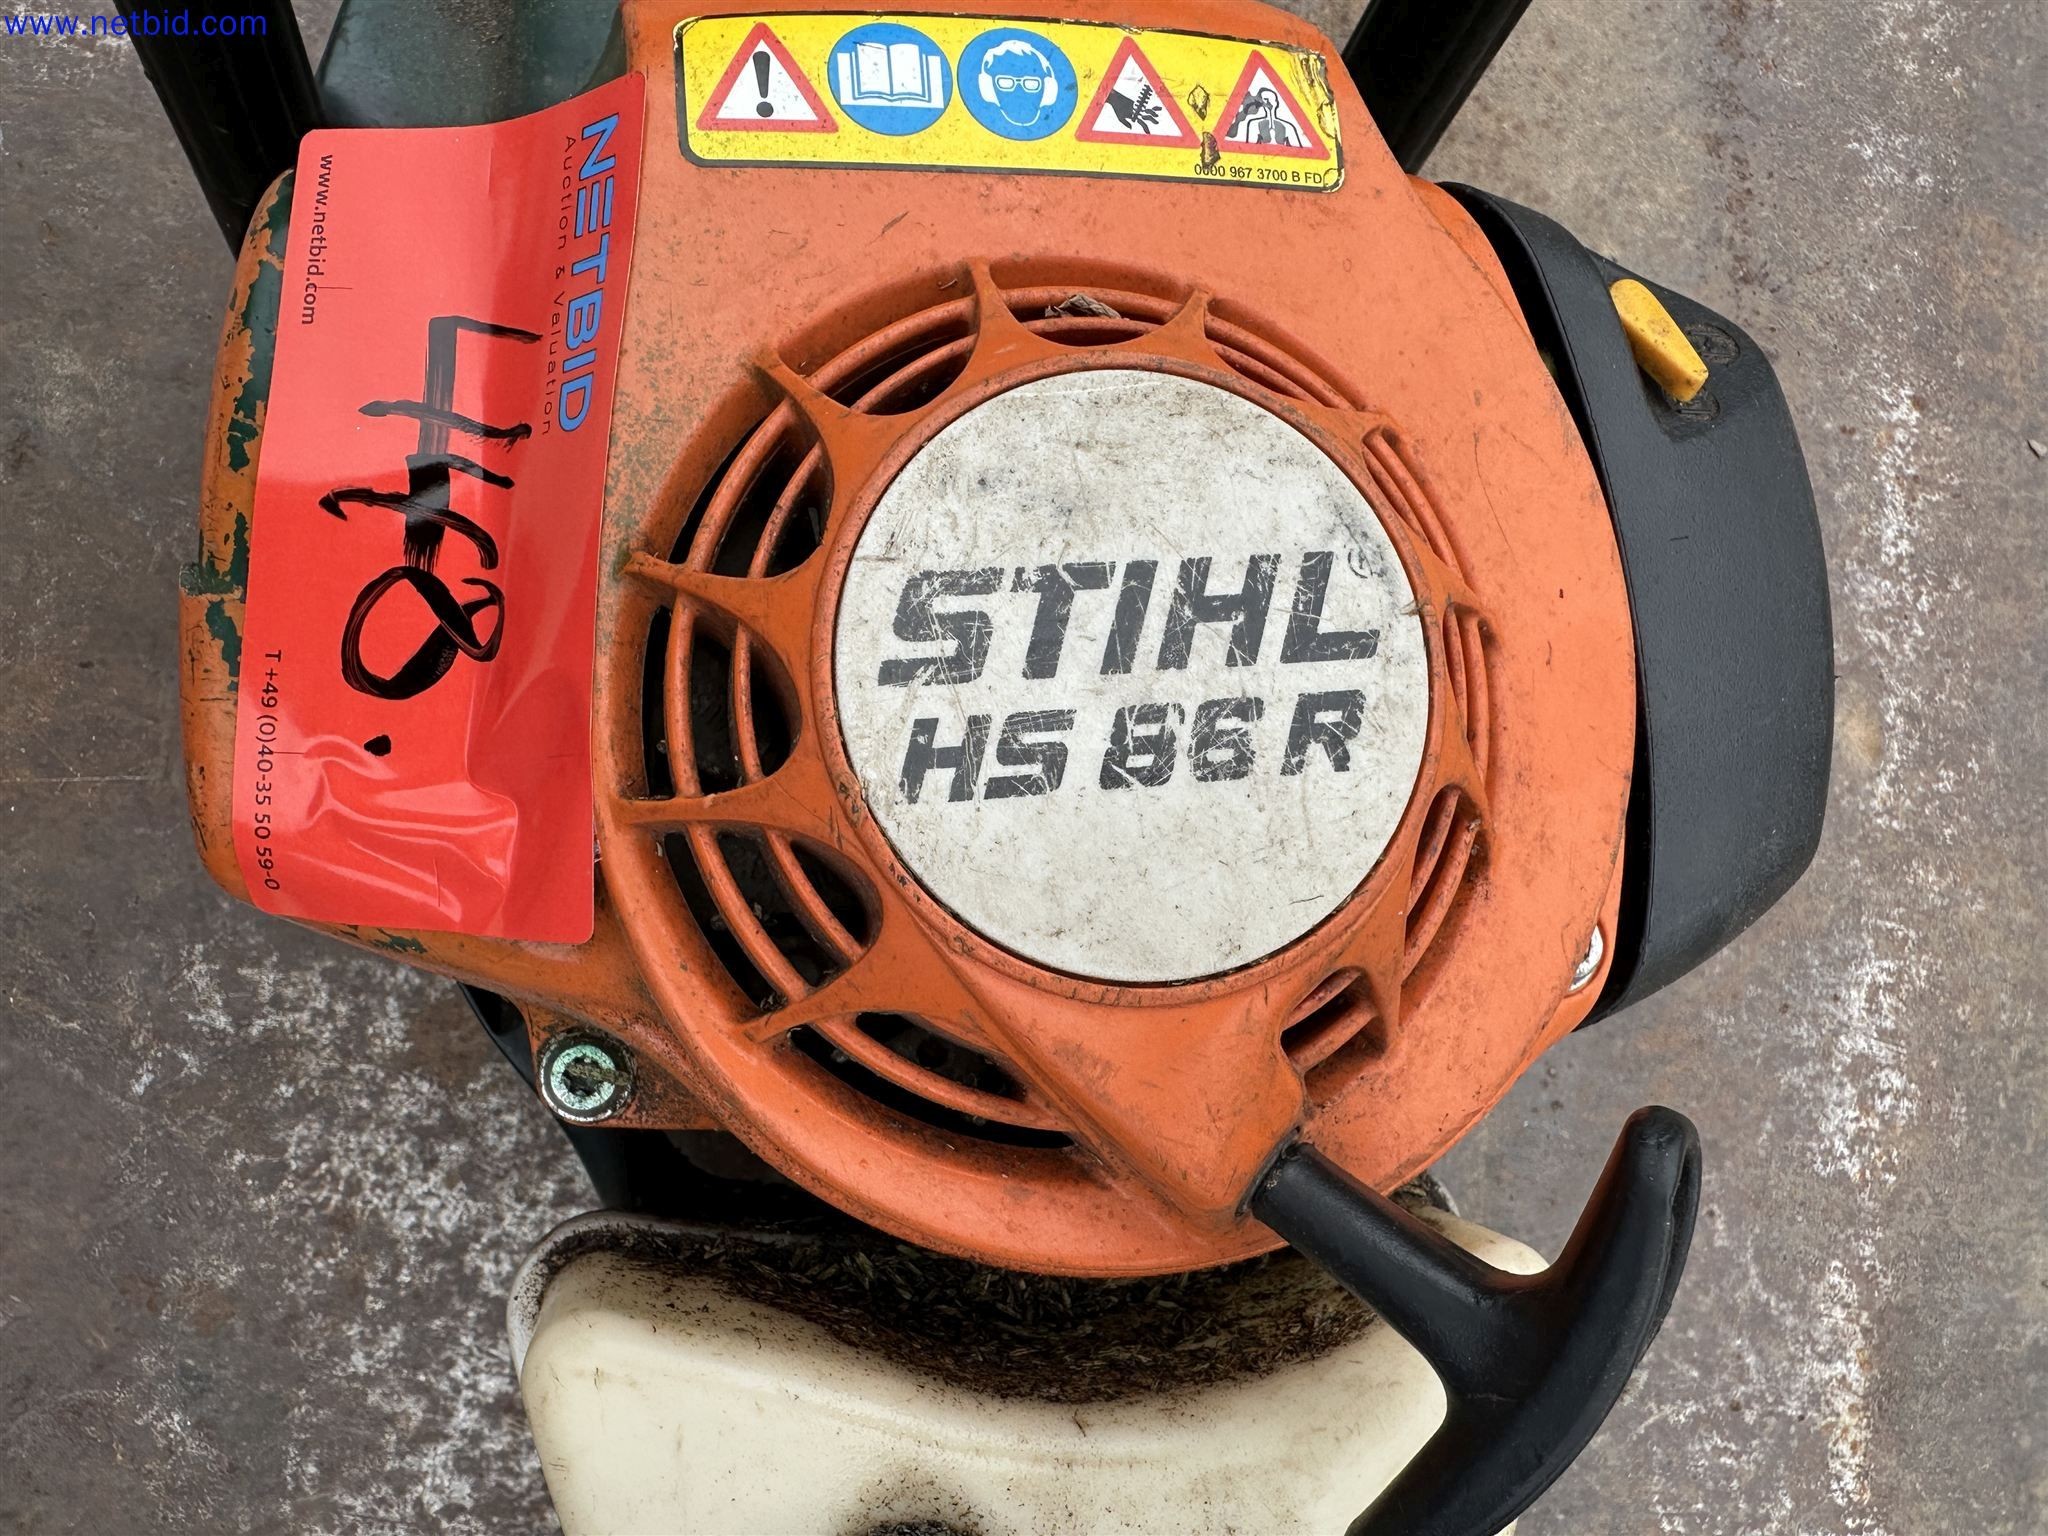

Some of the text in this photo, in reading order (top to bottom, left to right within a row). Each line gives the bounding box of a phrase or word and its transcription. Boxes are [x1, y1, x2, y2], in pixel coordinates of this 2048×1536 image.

[1230, 166, 1253, 178] 967
[1257, 168, 1288, 181] 3700
[1291, 172, 1301, 182] B
[1304, 172, 1323, 184] FD
[301, 154, 333, 325] www.netbid.com
[558, 112, 620, 432] NETBID
[542, 136, 577, 436] Auction & Valuation
[264, 649, 282, 662] T
[877, 550, 1381, 688] STIHL
[260, 667, 279, 708] +49
[898, 689, 1367, 804] HS 86 R
[254, 812, 271, 840] 50
[255, 845, 281, 891] 59-0
